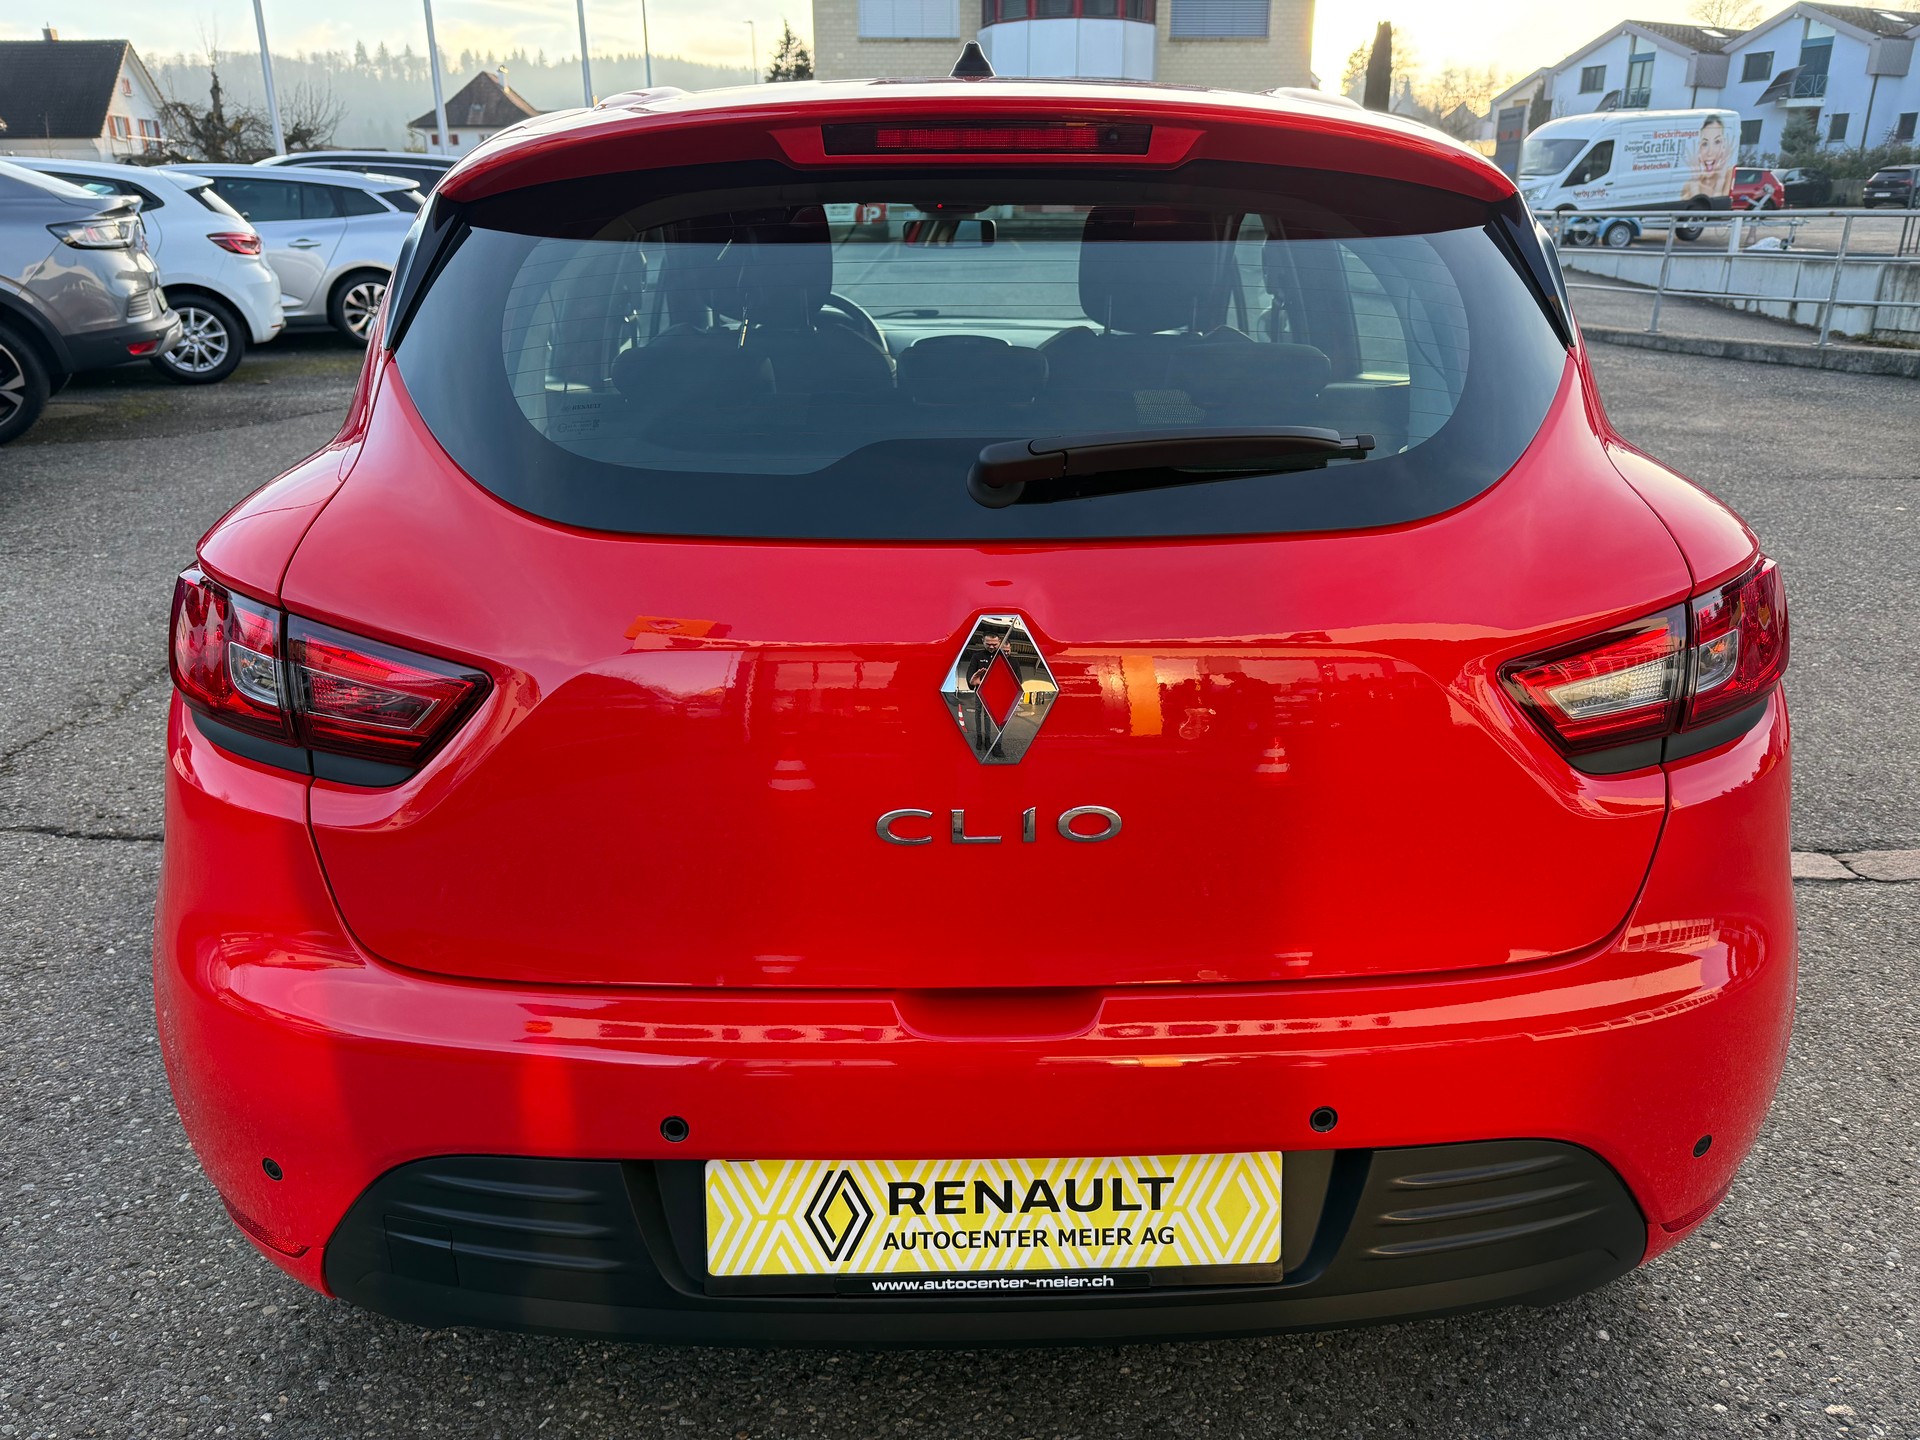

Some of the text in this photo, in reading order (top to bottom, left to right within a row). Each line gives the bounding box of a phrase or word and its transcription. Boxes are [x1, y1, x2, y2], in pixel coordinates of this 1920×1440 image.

[1653, 130, 1699, 139] Beschriftungen
[1643, 139, 1675, 153] Grafik
[875, 804, 1123, 846] CLIO
[887, 1176, 1175, 1216] RENAULT
[883, 1225, 1175, 1251] AUTOCENTER MEIER AG
[872, 1275, 1114, 1291] www.autocenter-meier.ch
